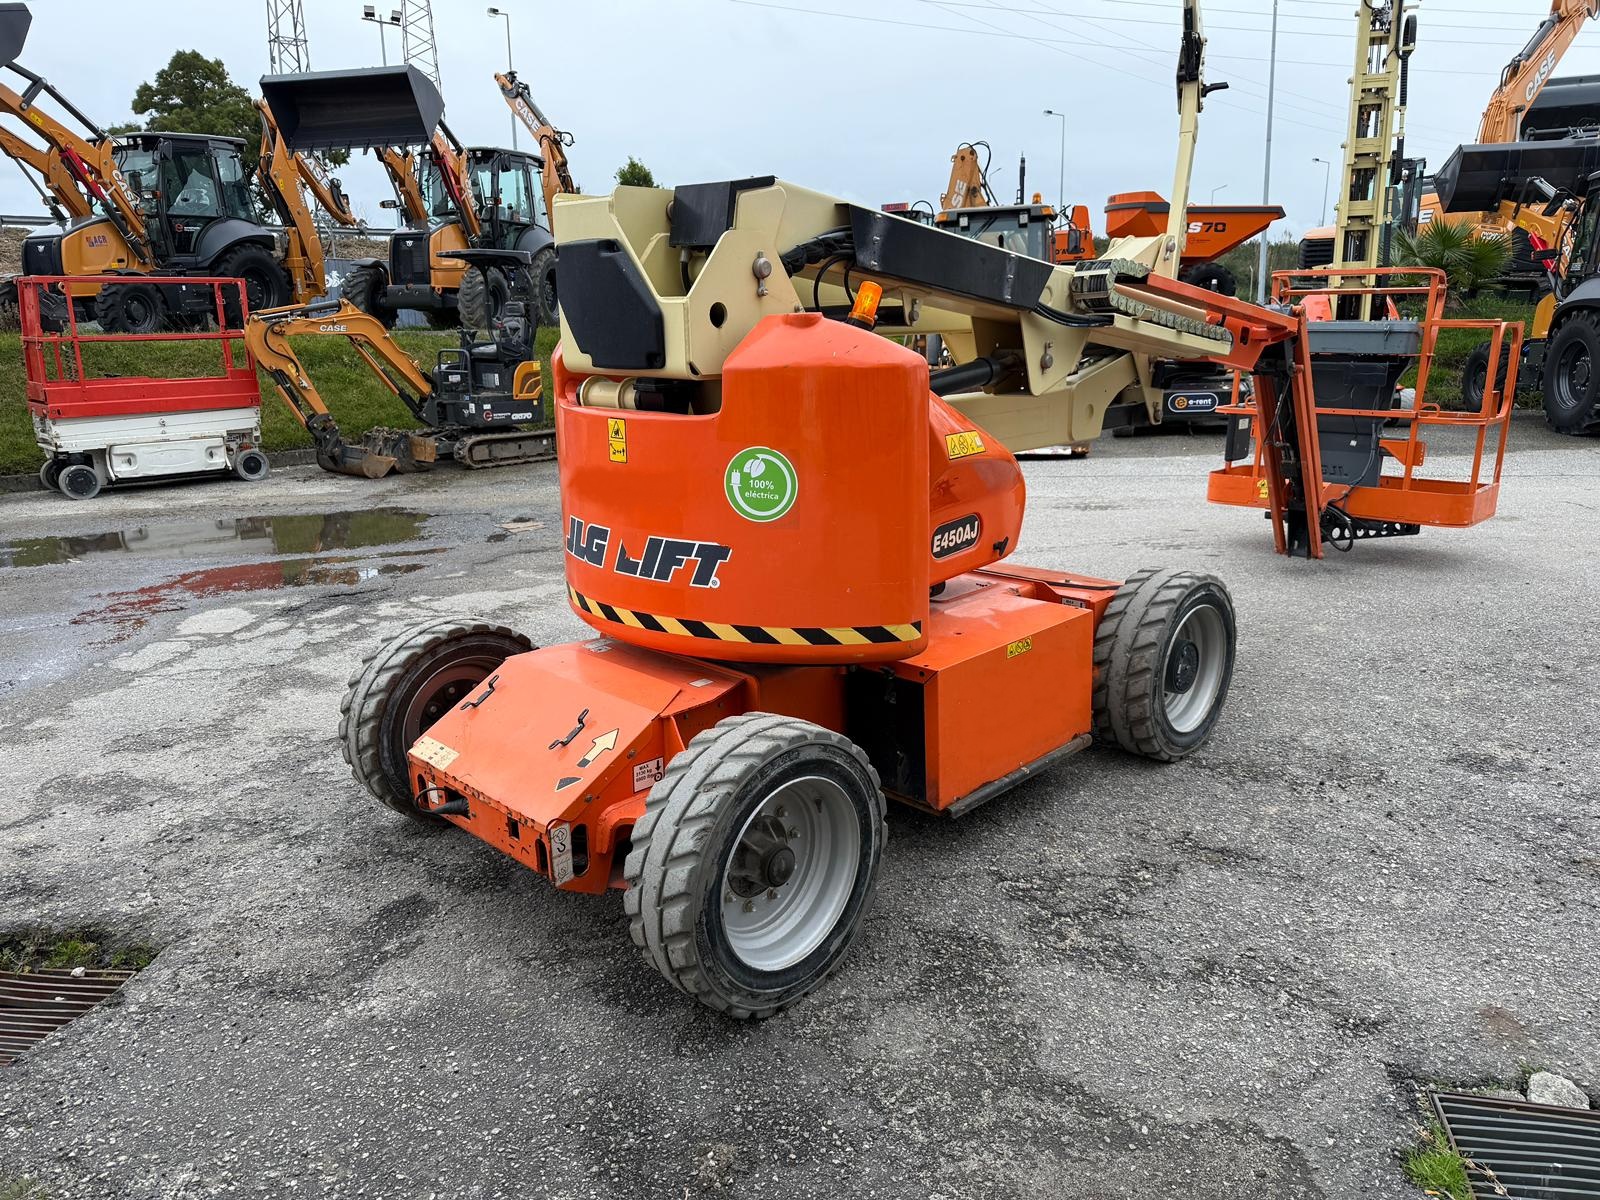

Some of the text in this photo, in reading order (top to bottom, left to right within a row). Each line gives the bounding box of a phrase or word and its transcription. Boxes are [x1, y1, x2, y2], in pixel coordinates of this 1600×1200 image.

[1525, 48, 1555, 102] CASE
[515, 99, 541, 132] CASE
[1188, 398, 1212, 406] e-rent
[745, 490, 779, 500] eléctrica
[749, 480, 775, 490] 100%
[565, 514, 732, 588] JLG LIFT
[932, 520, 978, 554] E450AJ
